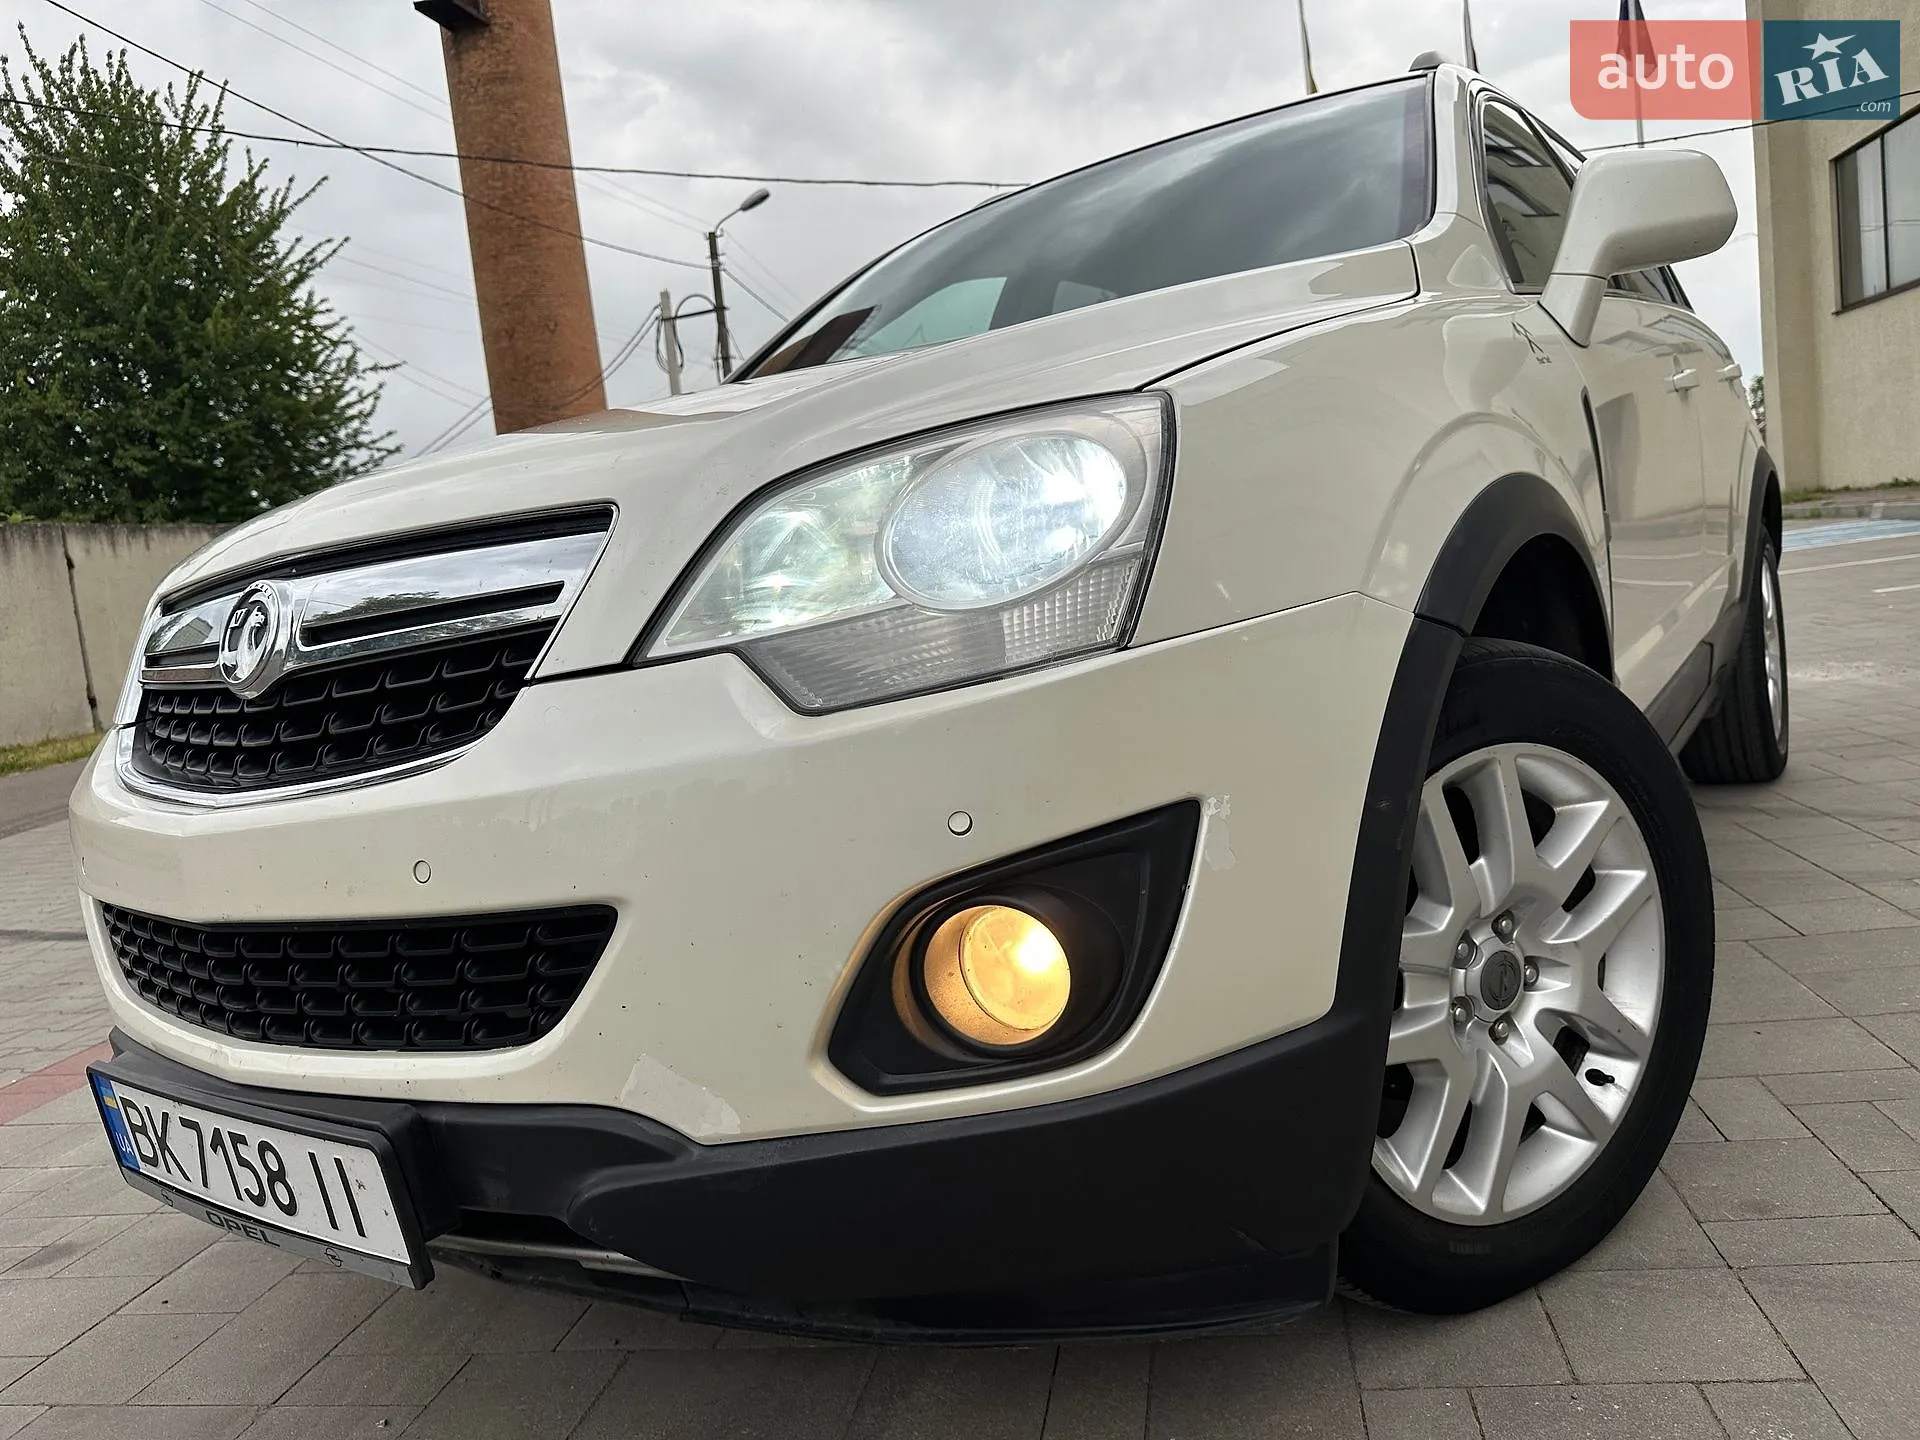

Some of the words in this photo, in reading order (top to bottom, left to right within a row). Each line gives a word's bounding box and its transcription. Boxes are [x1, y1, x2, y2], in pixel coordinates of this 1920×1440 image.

[115, 1132, 135, 1156] UA
[118, 1095, 192, 1183] BK
[178, 1115, 298, 1217] 7158
[205, 1210, 281, 1248] OPEL
